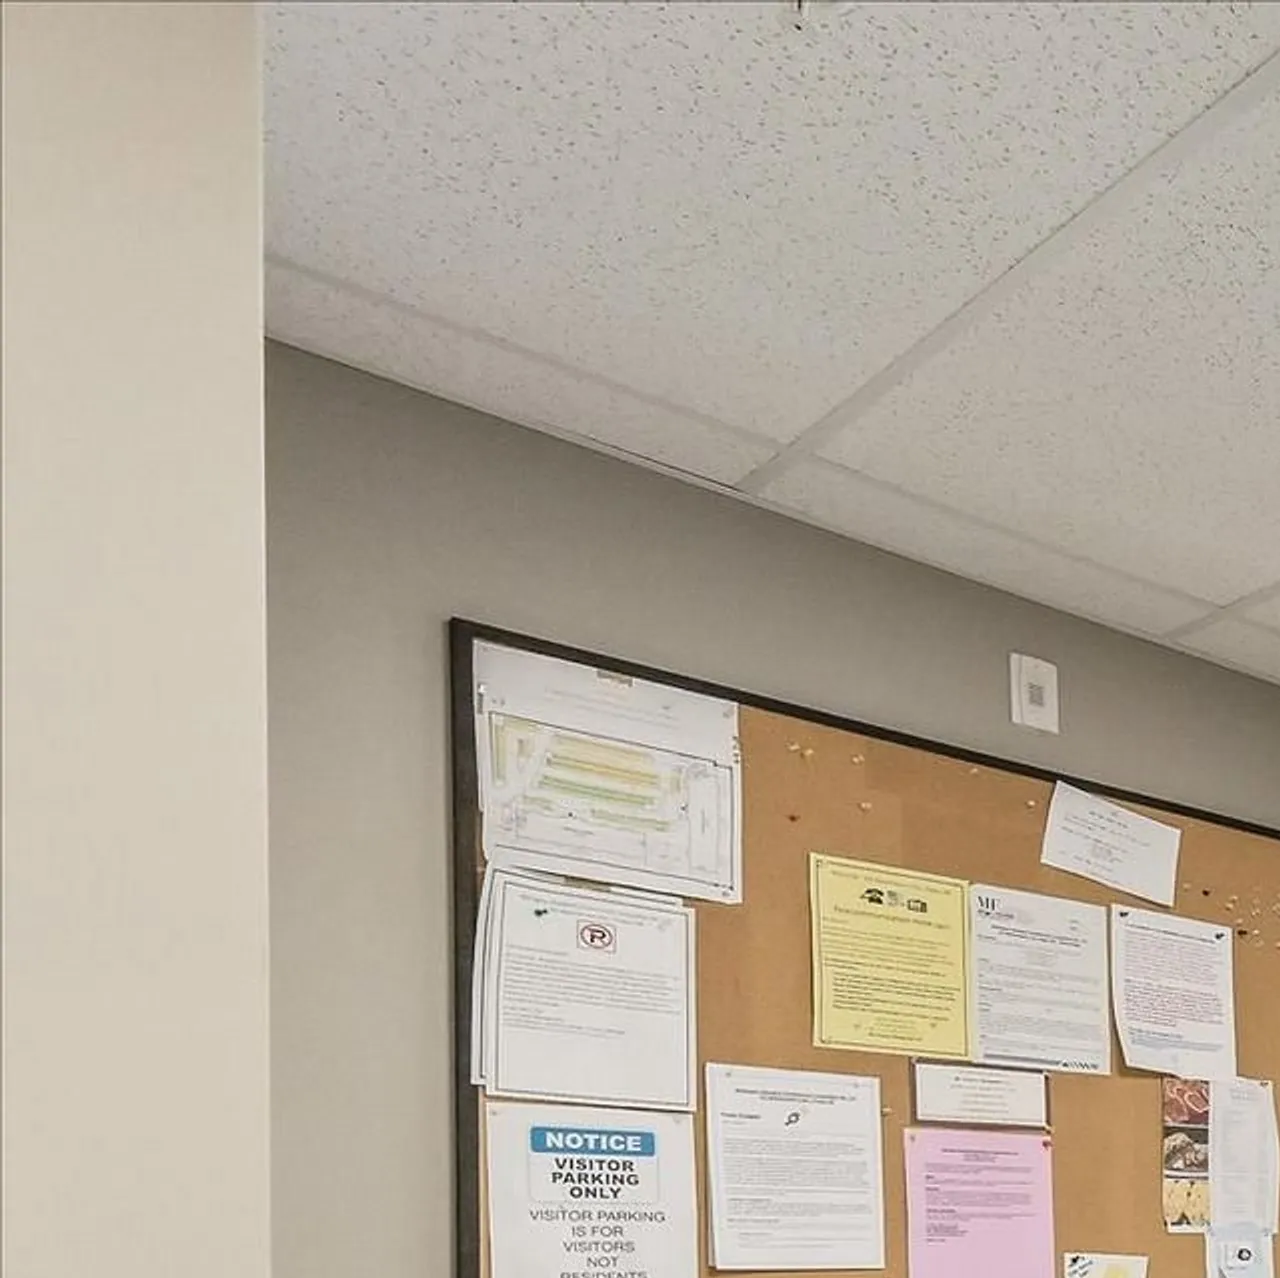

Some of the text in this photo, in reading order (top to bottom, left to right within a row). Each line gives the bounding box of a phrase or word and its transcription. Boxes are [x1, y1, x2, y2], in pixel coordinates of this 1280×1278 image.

[545, 1131, 642, 1151] NOTICE
[554, 1158, 635, 1172] VISITOR
[551, 1172, 640, 1186] PARKING
[569, 1186, 622, 1199] ONLY
[529, 1209, 666, 1223] VISITOR PARKING
[571, 1226, 624, 1238] IS FOR
[562, 1241, 636, 1253] VISITORS
[586, 1256, 619, 1268] NOT
